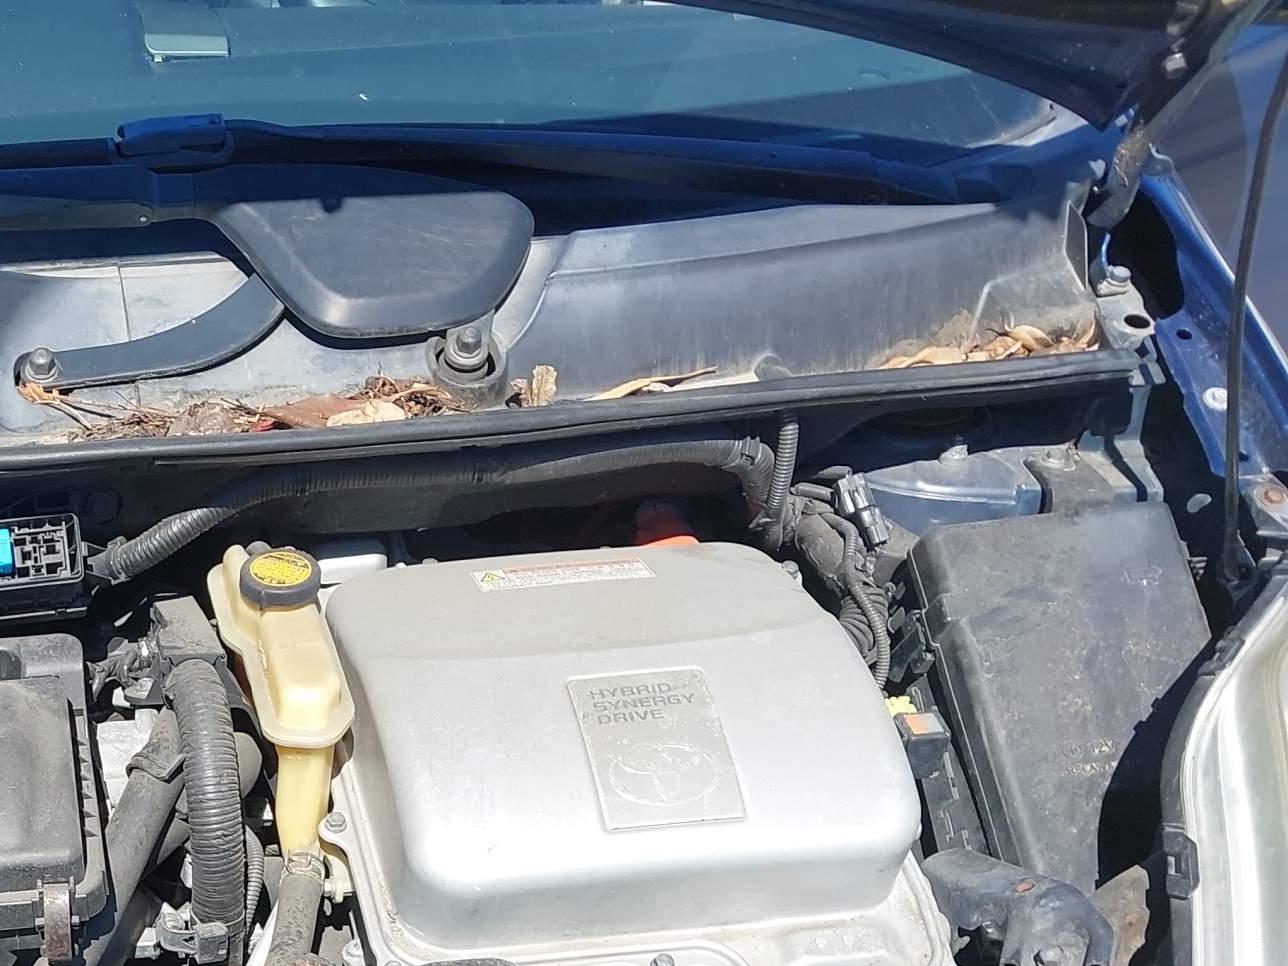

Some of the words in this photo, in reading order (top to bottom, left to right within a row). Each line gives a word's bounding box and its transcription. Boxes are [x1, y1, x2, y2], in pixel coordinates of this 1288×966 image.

[589, 682, 673, 701] HYBRID
[592, 692, 696, 713] SYNERGY
[597, 708, 665, 726] DRIVE
